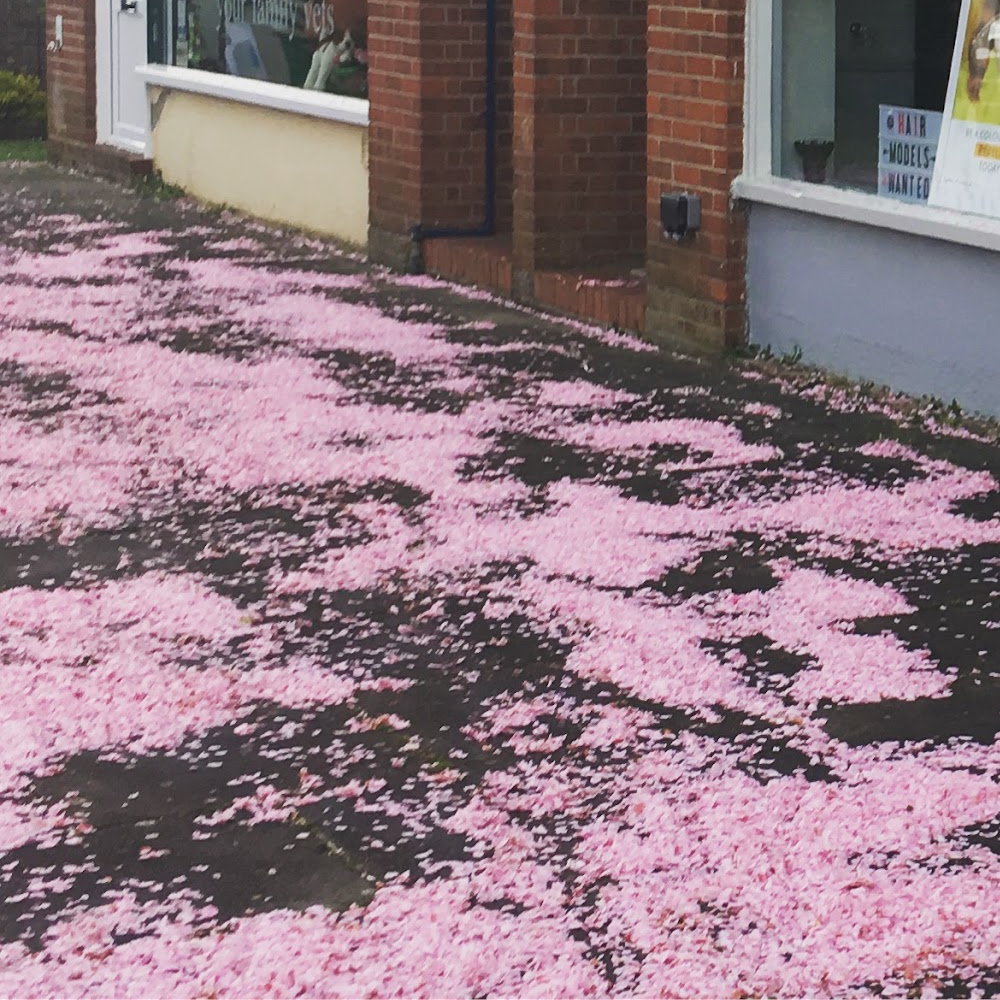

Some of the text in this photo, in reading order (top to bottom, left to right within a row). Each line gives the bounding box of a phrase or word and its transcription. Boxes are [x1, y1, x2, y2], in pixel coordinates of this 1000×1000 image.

[897, 112, 927, 138] HAIR
[888, 141, 930, 169] MODELS
[888, 172, 930, 200] WANTED
